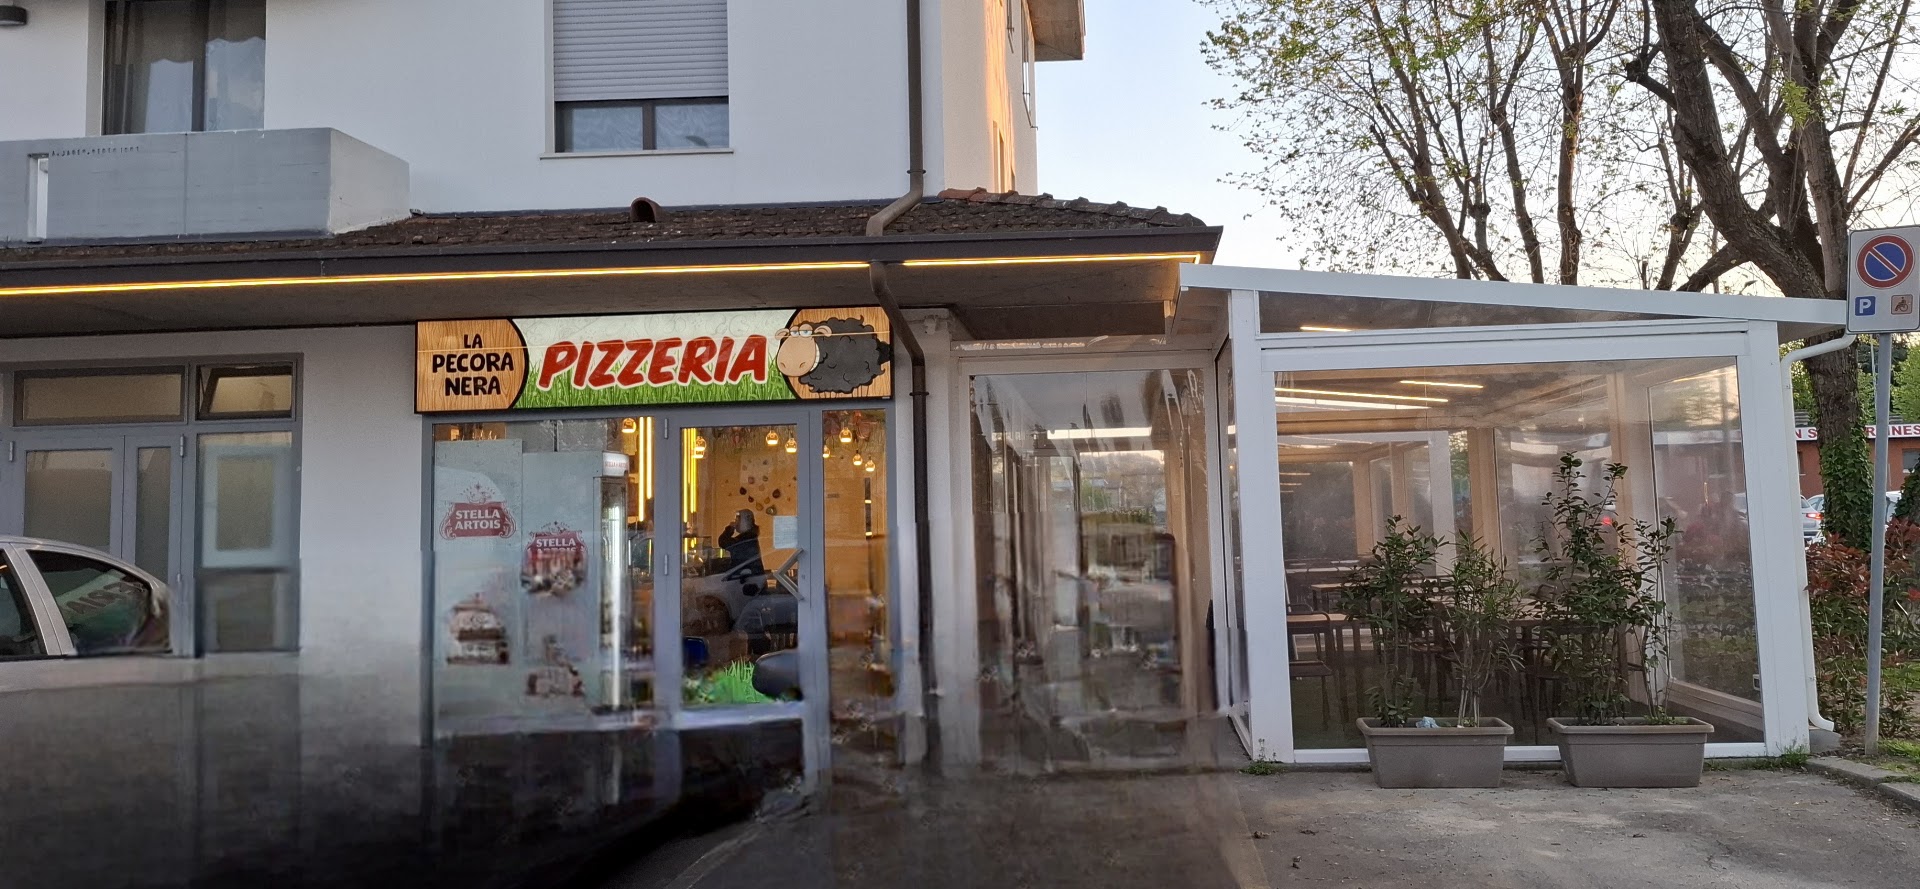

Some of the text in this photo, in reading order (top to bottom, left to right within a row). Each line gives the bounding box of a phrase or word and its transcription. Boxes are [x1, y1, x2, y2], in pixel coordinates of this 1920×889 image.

[1859, 299, 1872, 314] P
[463, 333, 483, 349] LA
[432, 352, 514, 373] PECORA
[538, 334, 767, 389] PIZZERIA
[445, 376, 501, 396] NERA
[455, 509, 501, 520] STELLA
[454, 519, 501, 530] ARTOIS
[536, 537, 577, 548] STELLA
